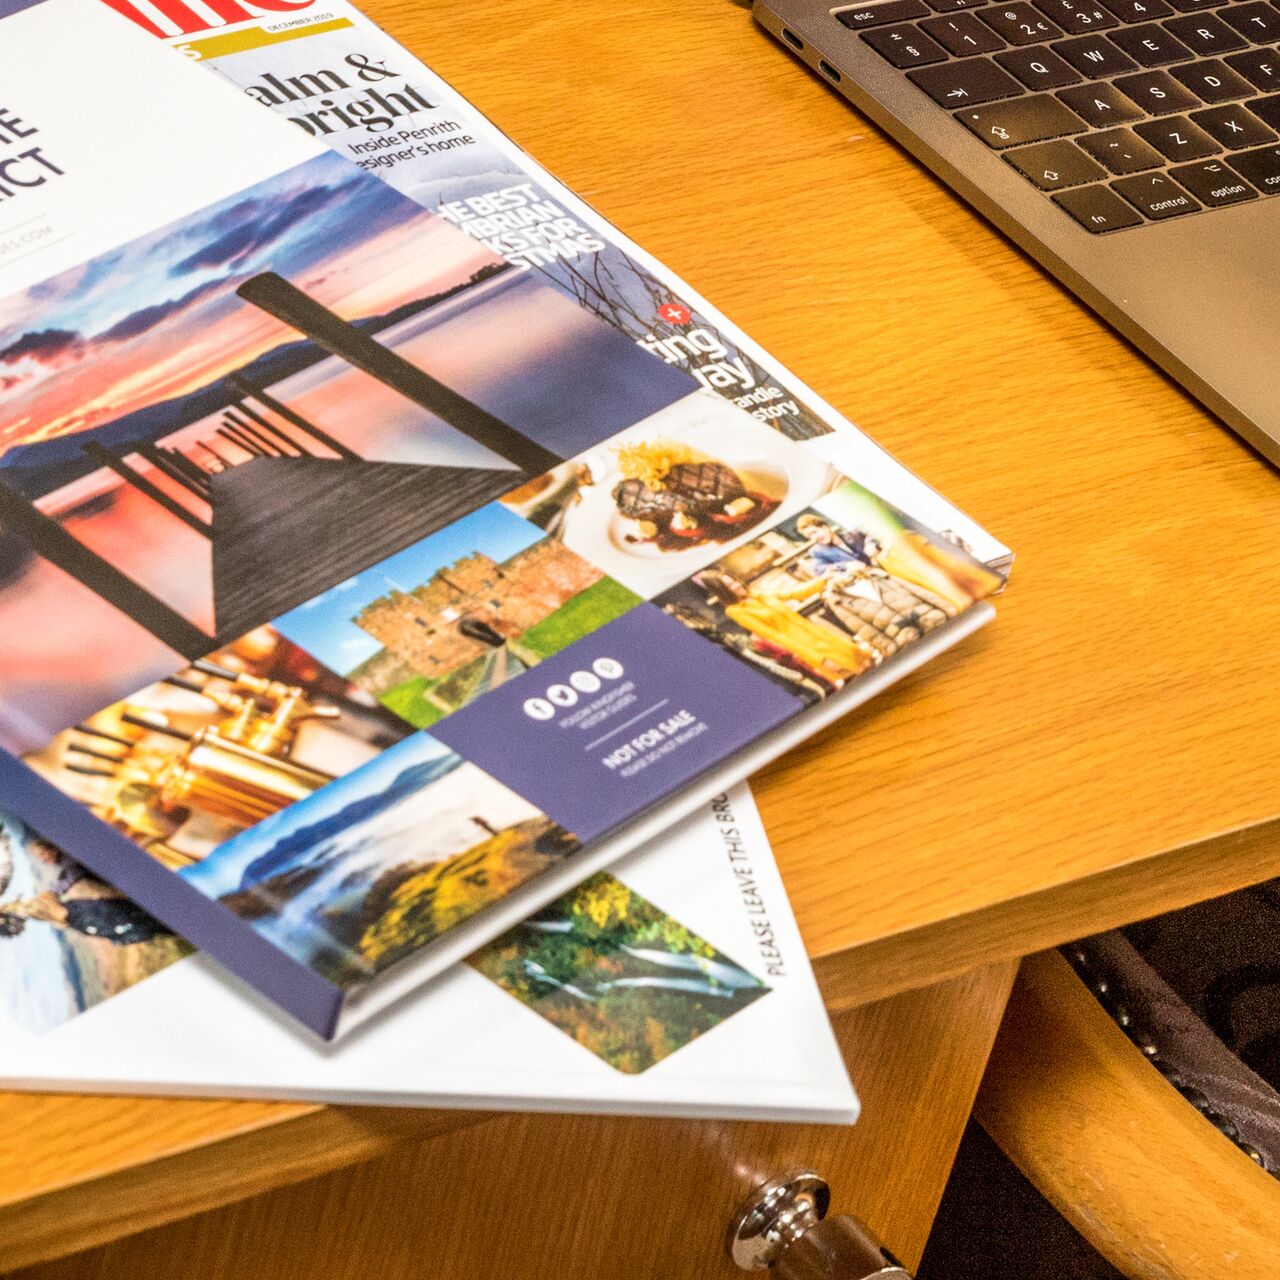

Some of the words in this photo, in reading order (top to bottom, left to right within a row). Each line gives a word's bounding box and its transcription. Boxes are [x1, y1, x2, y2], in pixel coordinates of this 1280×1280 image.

[267, 16, 313, 32] DECEMBER
[853, 10, 874, 21] esc
[244, 70, 352, 108] alm
[344, 53, 402, 82] &
[348, 131, 401, 155] Inside
[400, 119, 462, 142] Penrith
[356, 144, 429, 171] esigner's
[427, 134, 476, 153] home
[464, 183, 541, 218] BEST
[1150, 195, 1189, 212] control
[1211, 183, 1246, 198] option
[525, 217, 588, 245] FOR
[1091, 212, 1107, 225] fn
[602, 743, 638, 769] NOT
[631, 728, 666, 752] FOR
[658, 709, 697, 735] SALE
[711, 792, 736, 822] BRO
[720, 826, 748, 863] THIS
[733, 866, 766, 915] LEAVE
[750, 919, 787, 978] PLEASE
